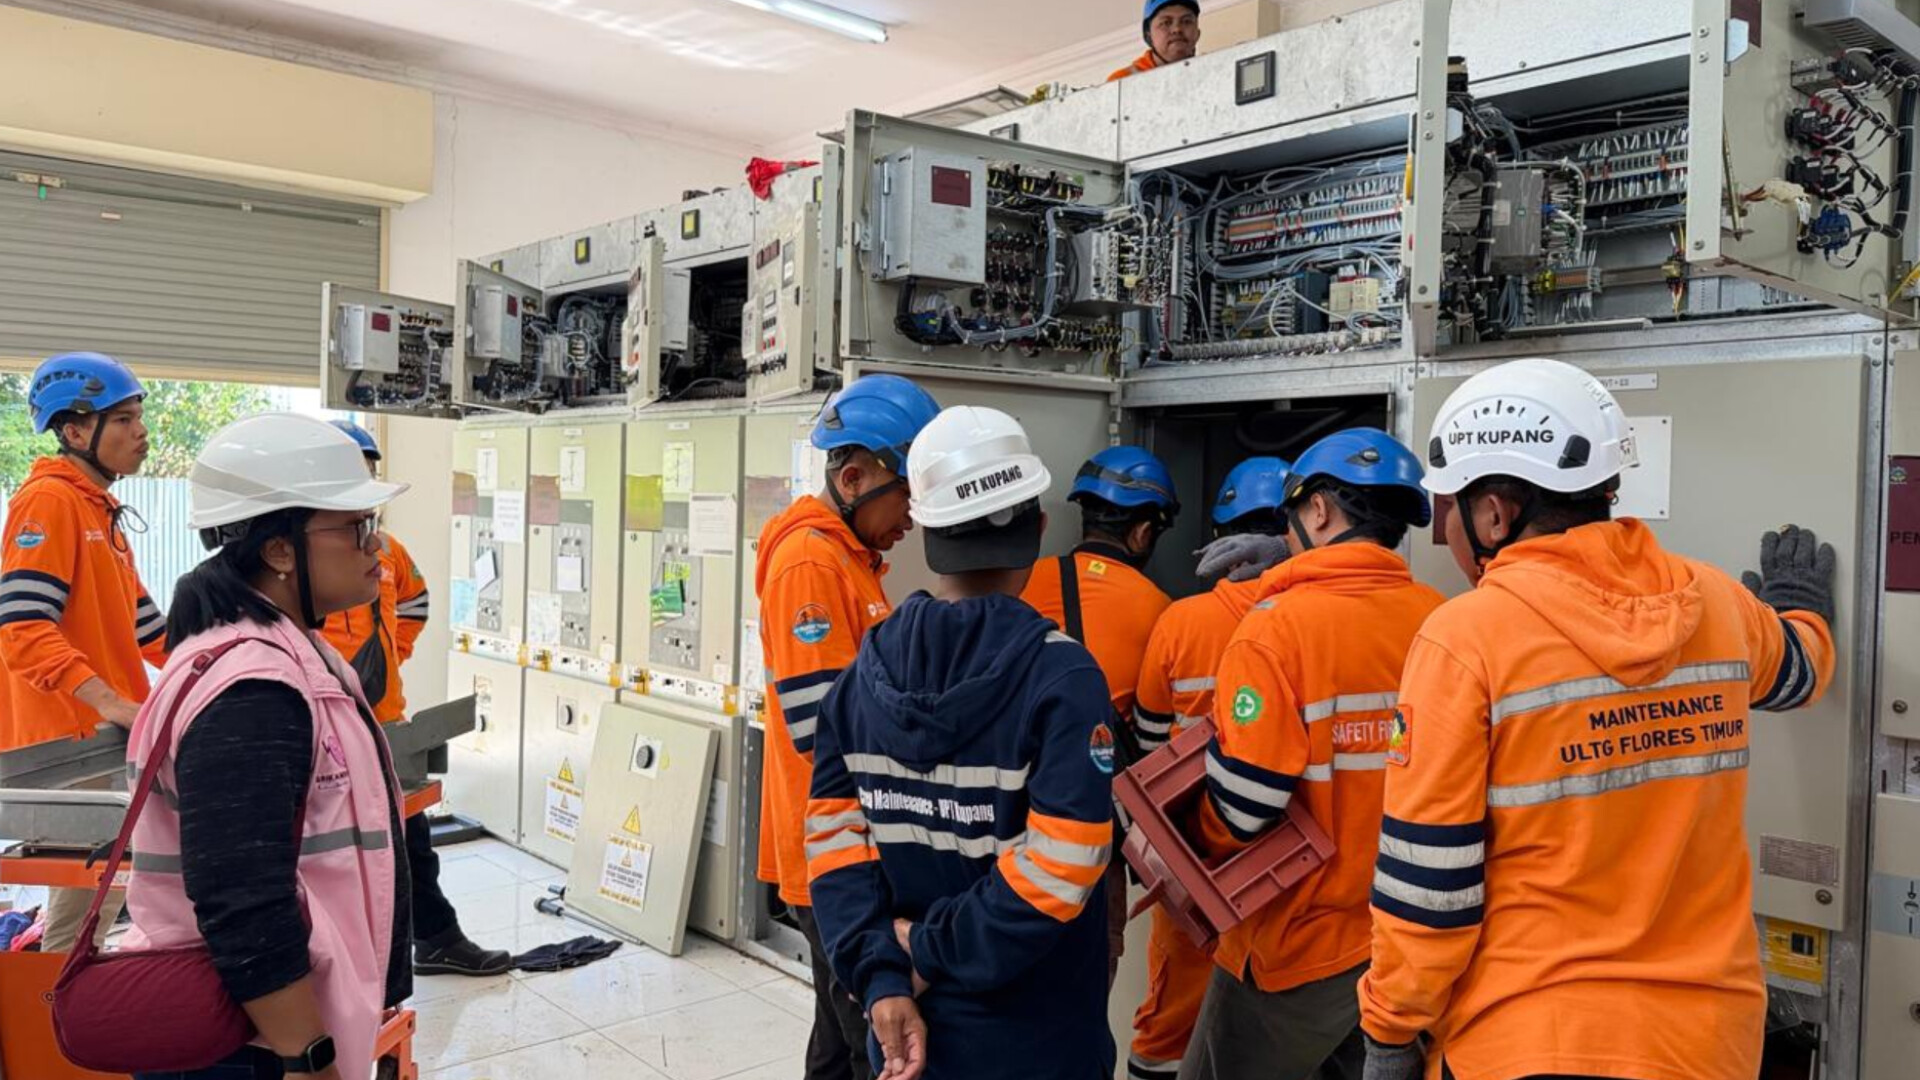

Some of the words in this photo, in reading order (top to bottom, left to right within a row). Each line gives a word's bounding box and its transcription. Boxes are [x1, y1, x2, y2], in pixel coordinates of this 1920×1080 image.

[1448, 432, 1473, 445] UPT
[1477, 429, 1554, 445] KUPANG
[955, 480, 979, 499] UPT
[979, 465, 1022, 492] KUPANG
[1589, 694, 1724, 731] MAINTENANCE
[1332, 721, 1374, 745] SAFETY
[1378, 720, 1394, 743] FIR
[1560, 740, 1614, 763] ULTG
[1619, 727, 1696, 755] FLORES
[1699, 719, 1744, 742] TIMUR
